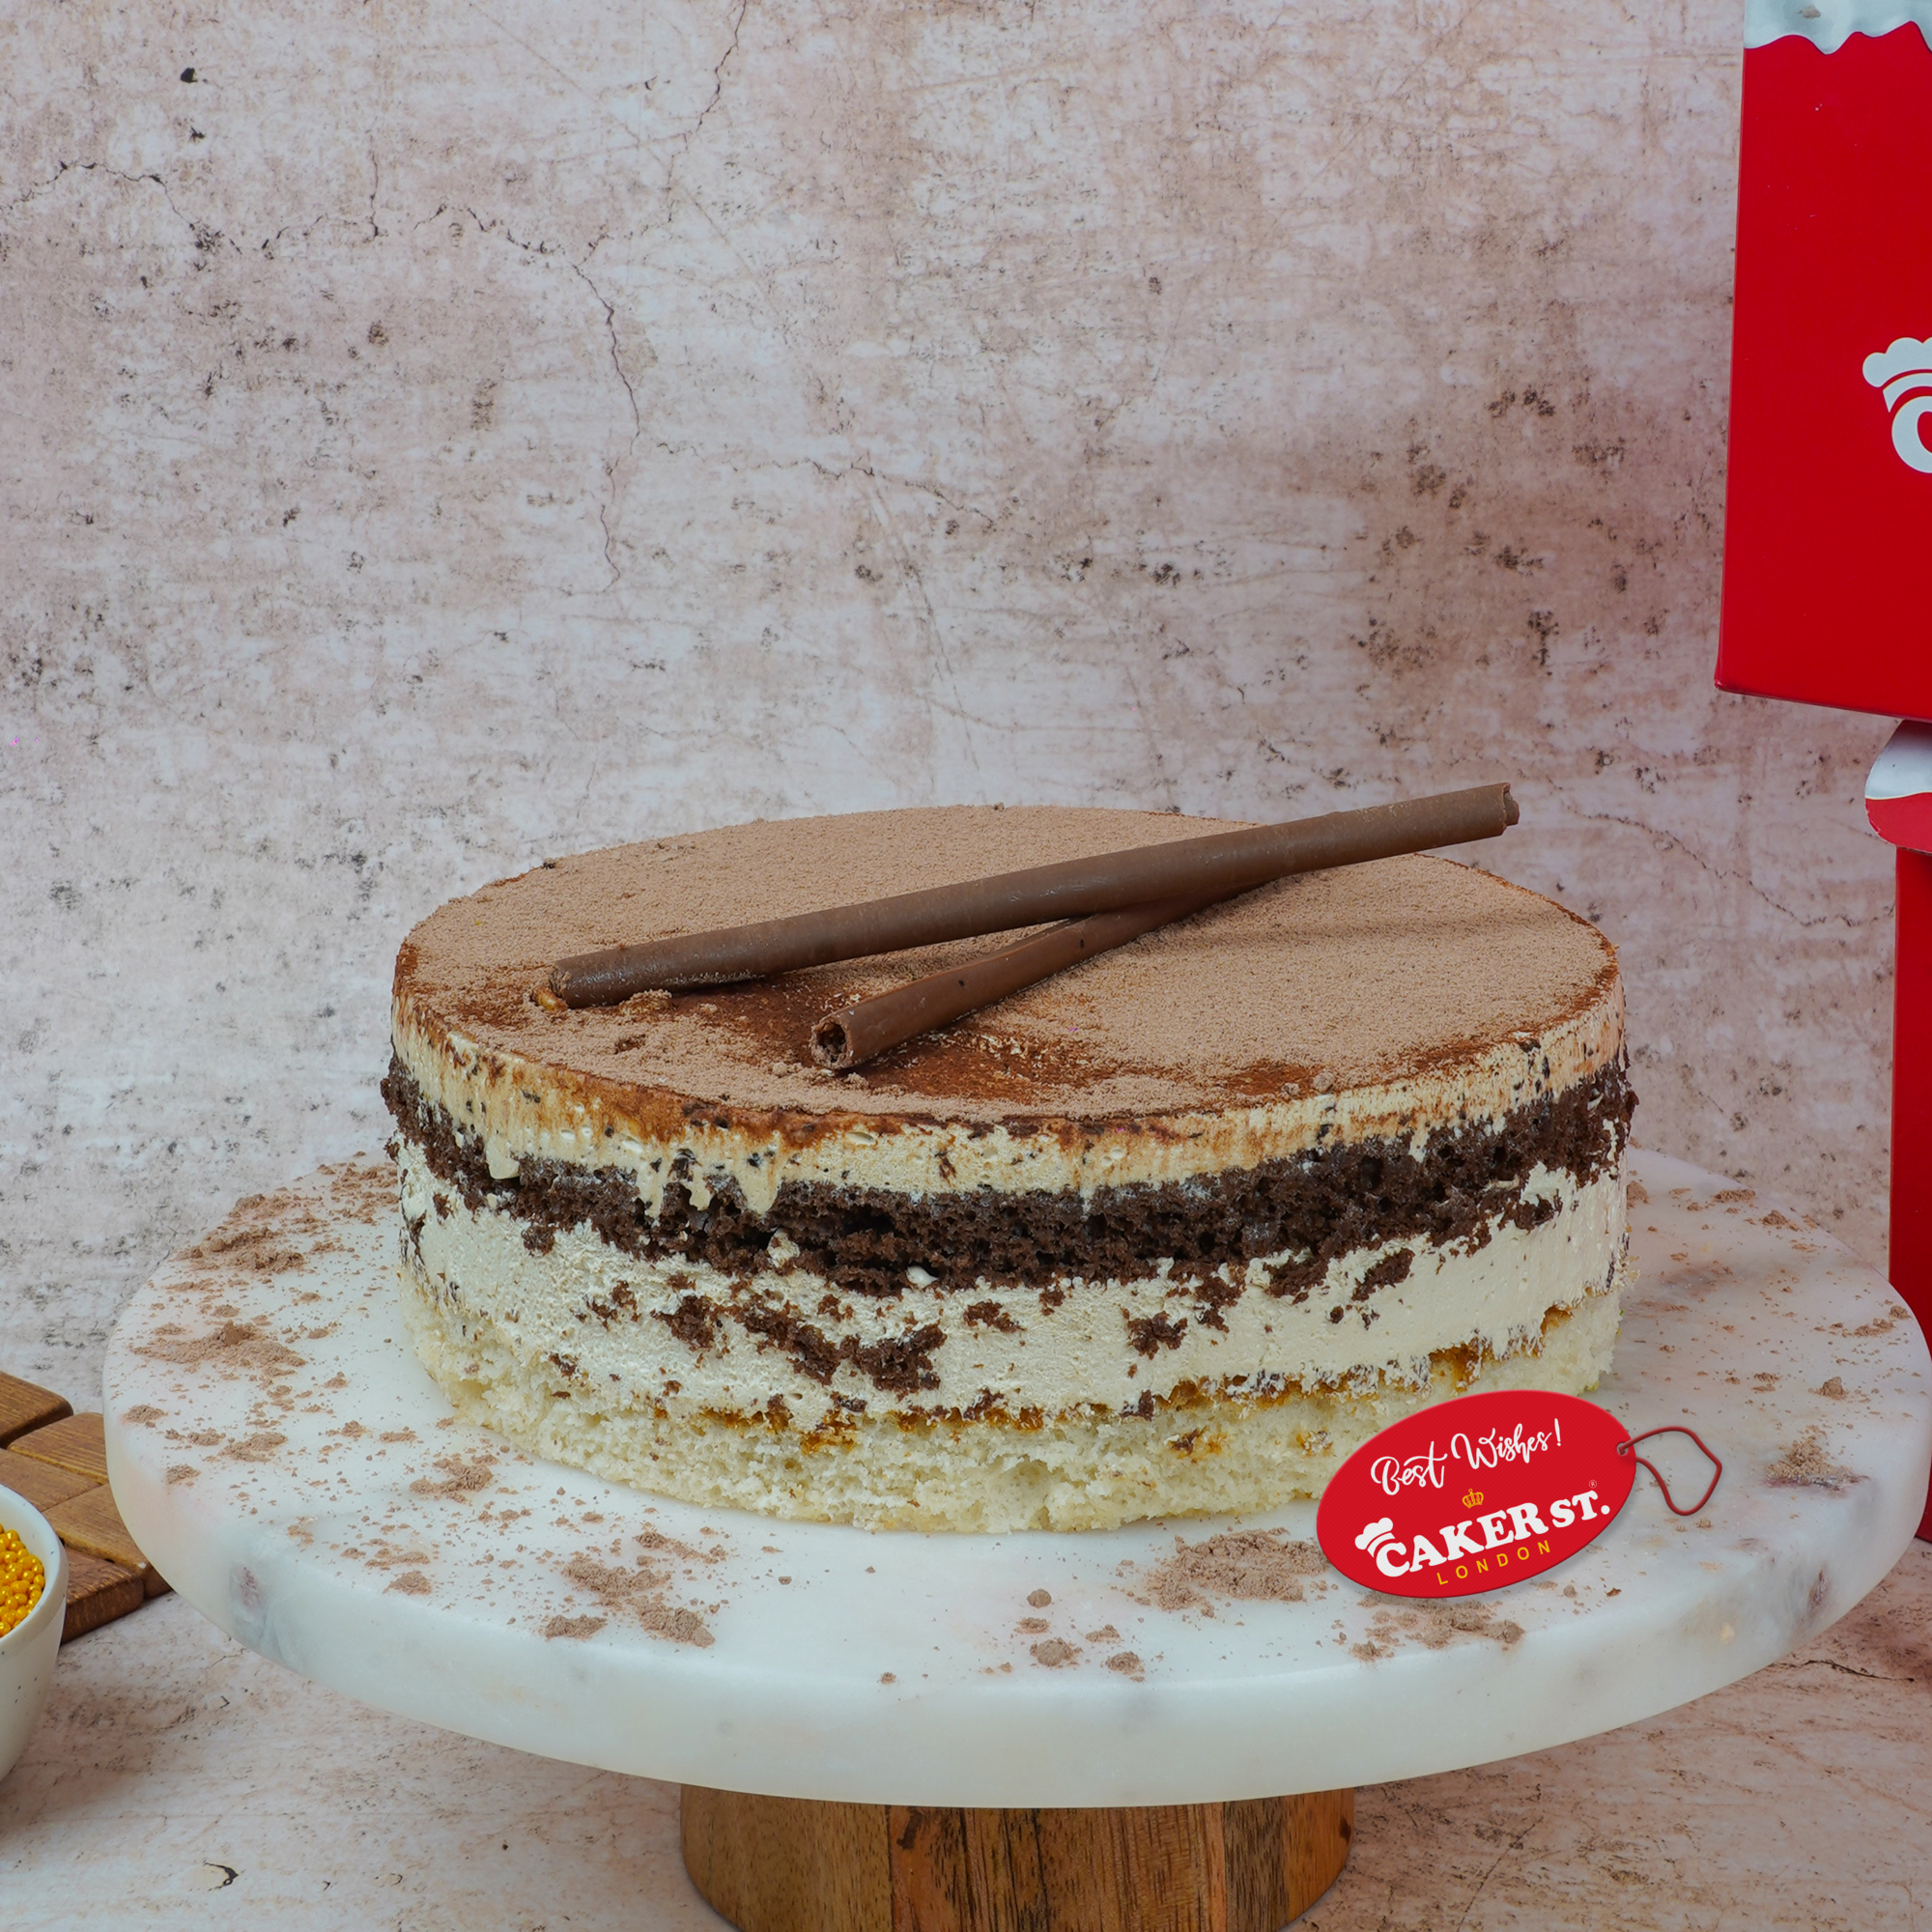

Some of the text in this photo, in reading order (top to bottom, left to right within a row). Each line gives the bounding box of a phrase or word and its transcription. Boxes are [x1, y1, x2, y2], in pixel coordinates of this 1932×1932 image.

[1370, 1417, 1562, 1496] Best Wishes!
[1376, 1502, 1549, 1577] CAKER
[1436, 1539, 1550, 1585] LONDON
